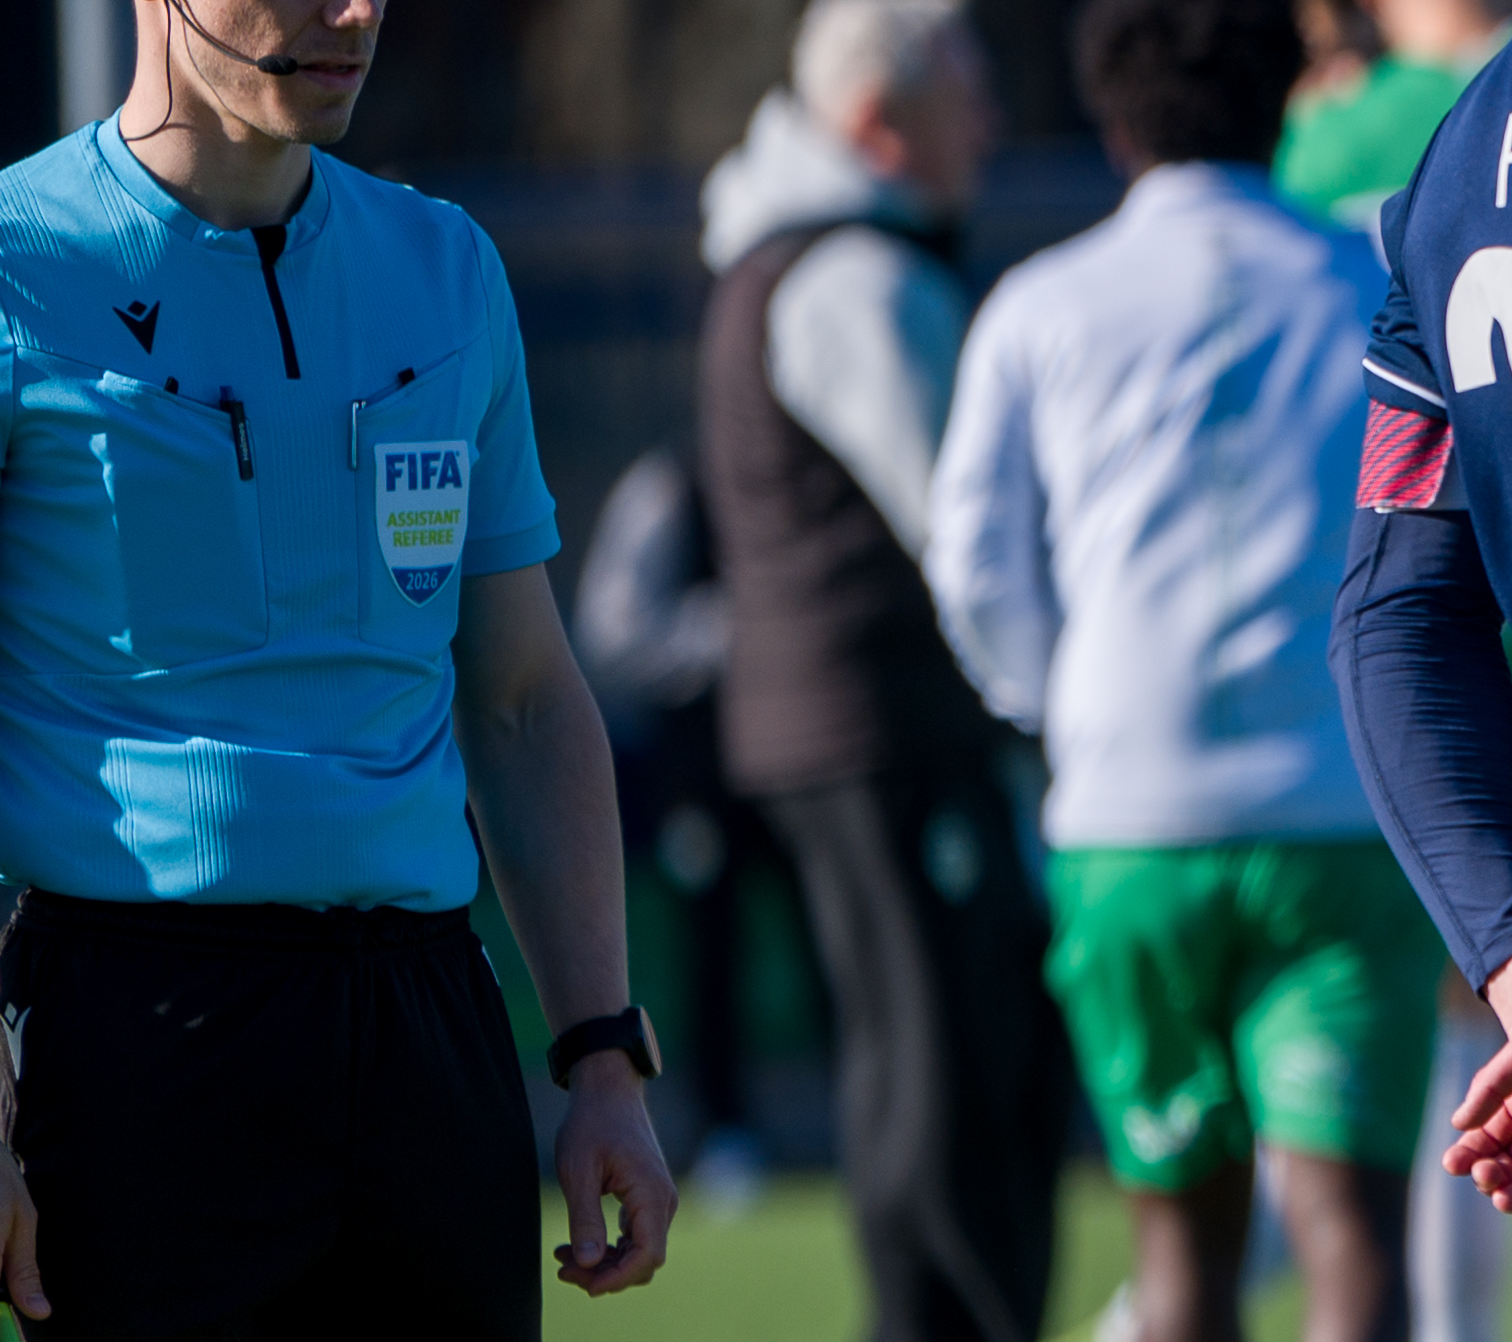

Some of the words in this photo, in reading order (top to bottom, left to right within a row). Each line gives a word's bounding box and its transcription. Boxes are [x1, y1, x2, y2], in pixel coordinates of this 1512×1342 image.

[385, 451, 462, 492] FIFA
[387, 509, 461, 528] ASSISTANT
[393, 528, 454, 547] REFEREE
[406, 571, 438, 590] 2026
